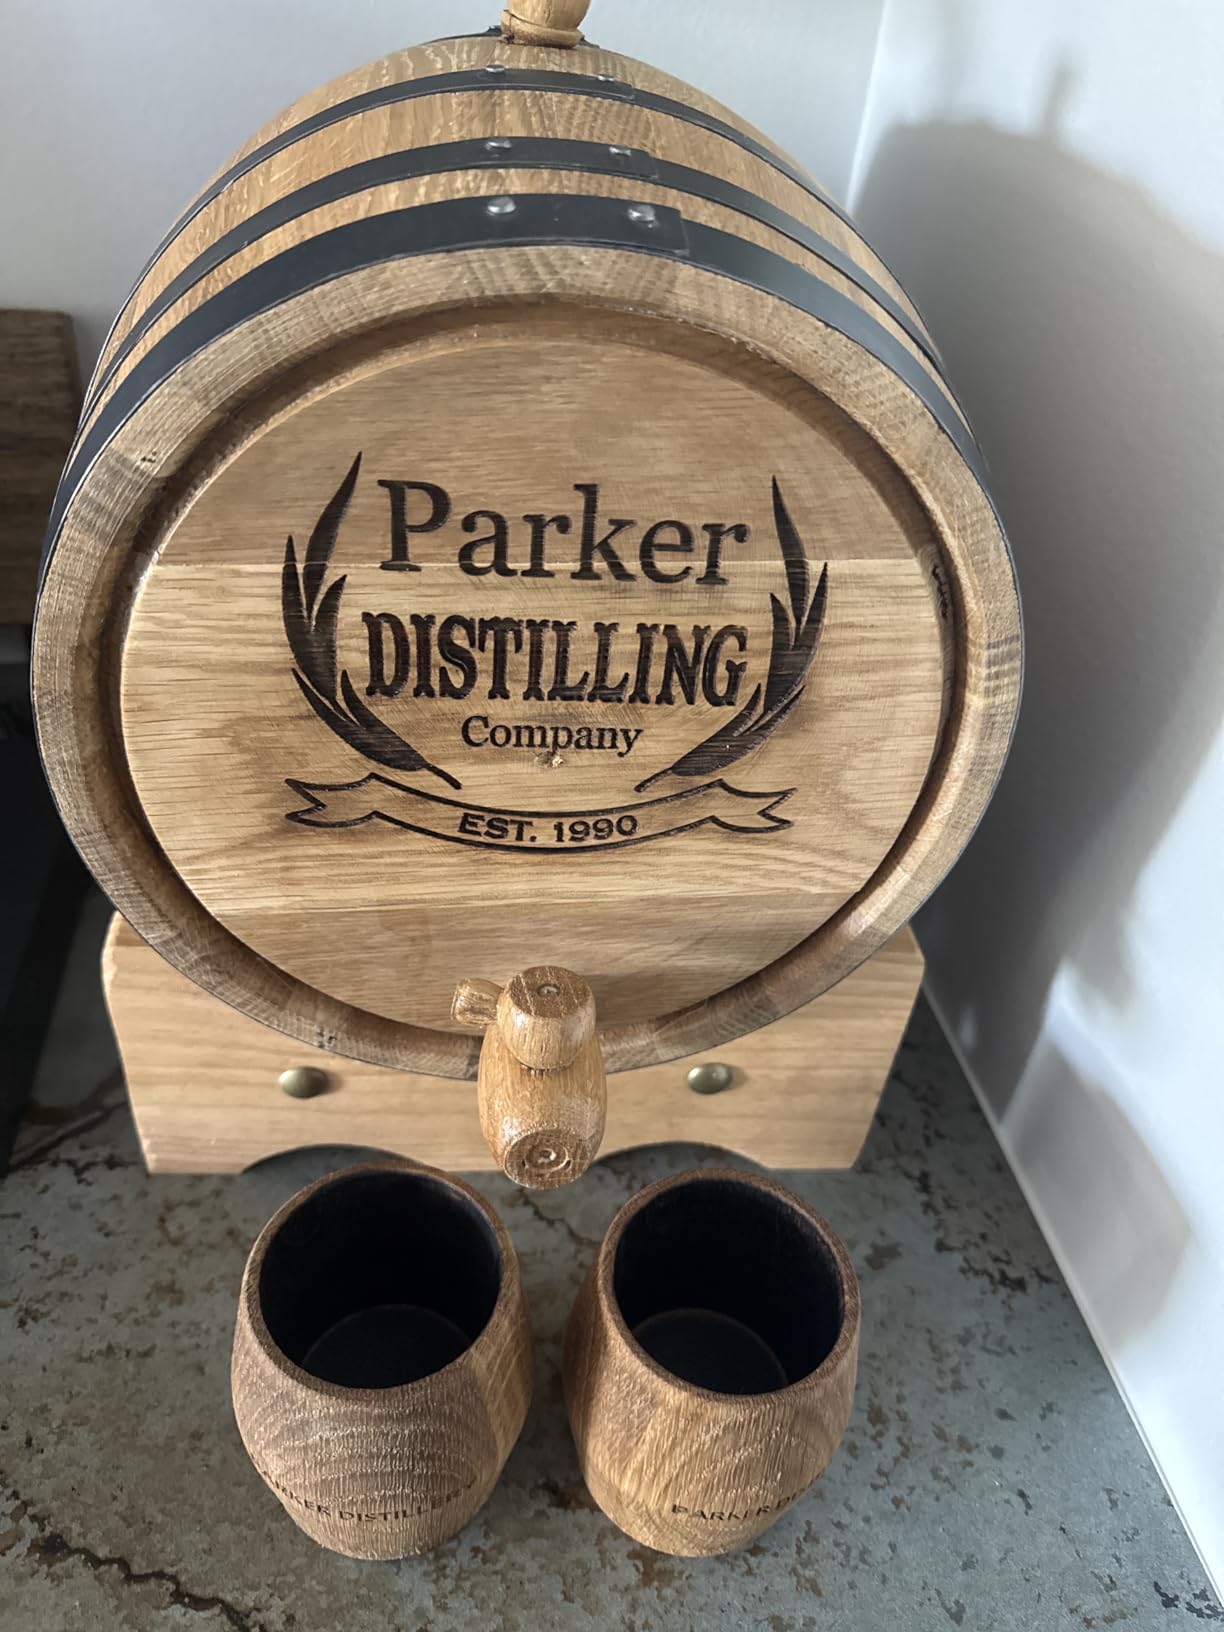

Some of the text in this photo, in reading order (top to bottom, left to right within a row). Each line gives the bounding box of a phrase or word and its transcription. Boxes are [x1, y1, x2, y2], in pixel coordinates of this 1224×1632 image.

[378, 479, 750, 585] Parker
[361, 611, 749, 706] DISTILLING
[461, 715, 644, 757] Company
[457, 812, 639, 842] EST. 1990
